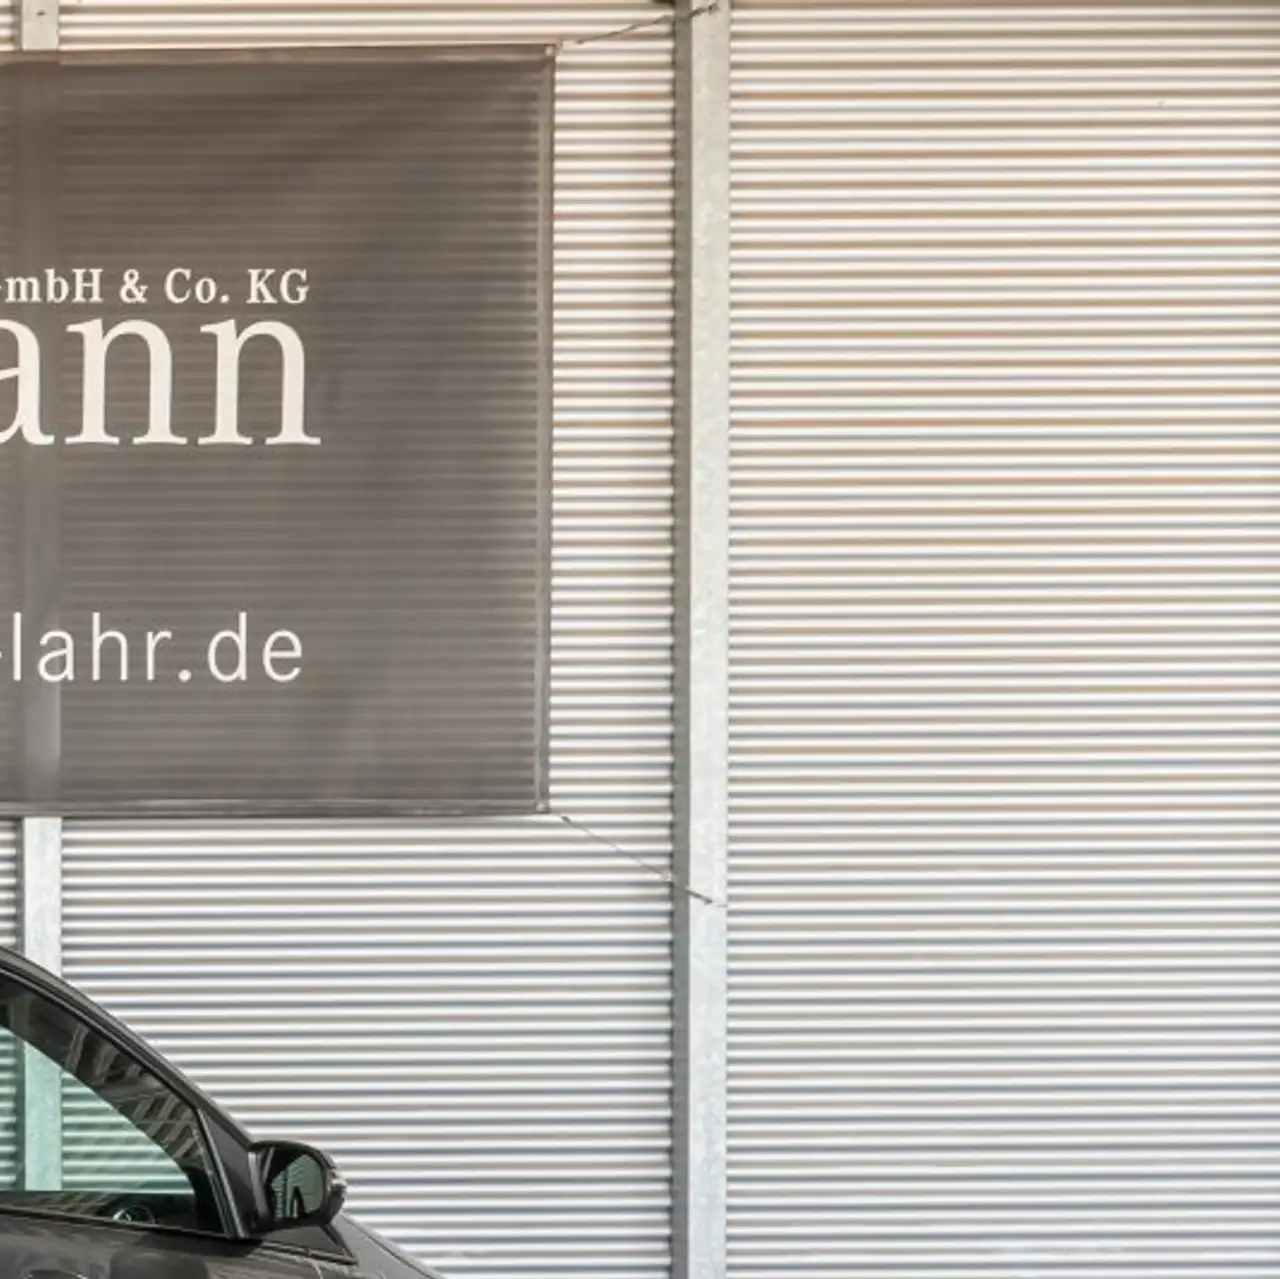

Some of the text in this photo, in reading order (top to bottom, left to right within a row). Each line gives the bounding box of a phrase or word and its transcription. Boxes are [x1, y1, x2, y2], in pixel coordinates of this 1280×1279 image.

[119, 268, 149, 304] &
[164, 267, 230, 304] Co.
[246, 267, 310, 304] KG
